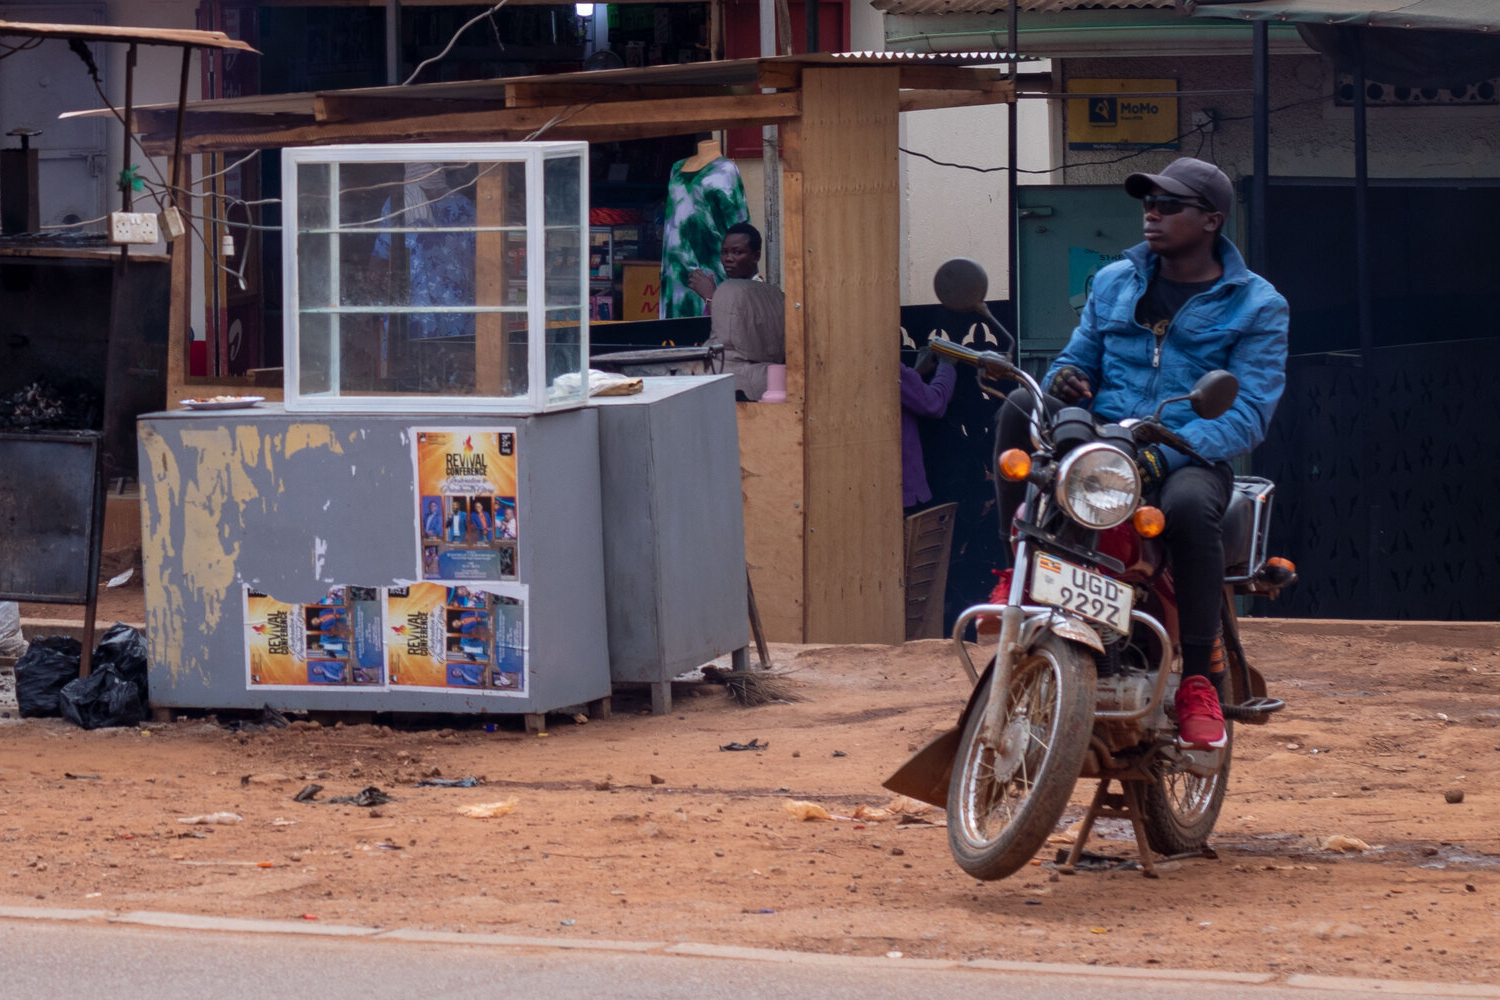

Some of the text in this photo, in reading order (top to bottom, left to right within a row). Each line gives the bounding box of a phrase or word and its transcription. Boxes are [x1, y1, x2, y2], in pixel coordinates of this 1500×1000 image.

[1121, 103, 1158, 114] MoMo
[446, 453, 487, 468] REVIVAL
[446, 467, 487, 476] CONFERENCE
[1072, 568, 1118, 601] UGD
[1060, 587, 1120, 626] 929Z
[268, 610, 280, 654] REVIVAL
[280, 611, 289, 655] CONFERENCE
[407, 611, 420, 655] REVIVAL
[419, 612, 428, 656] CONFERENCE
